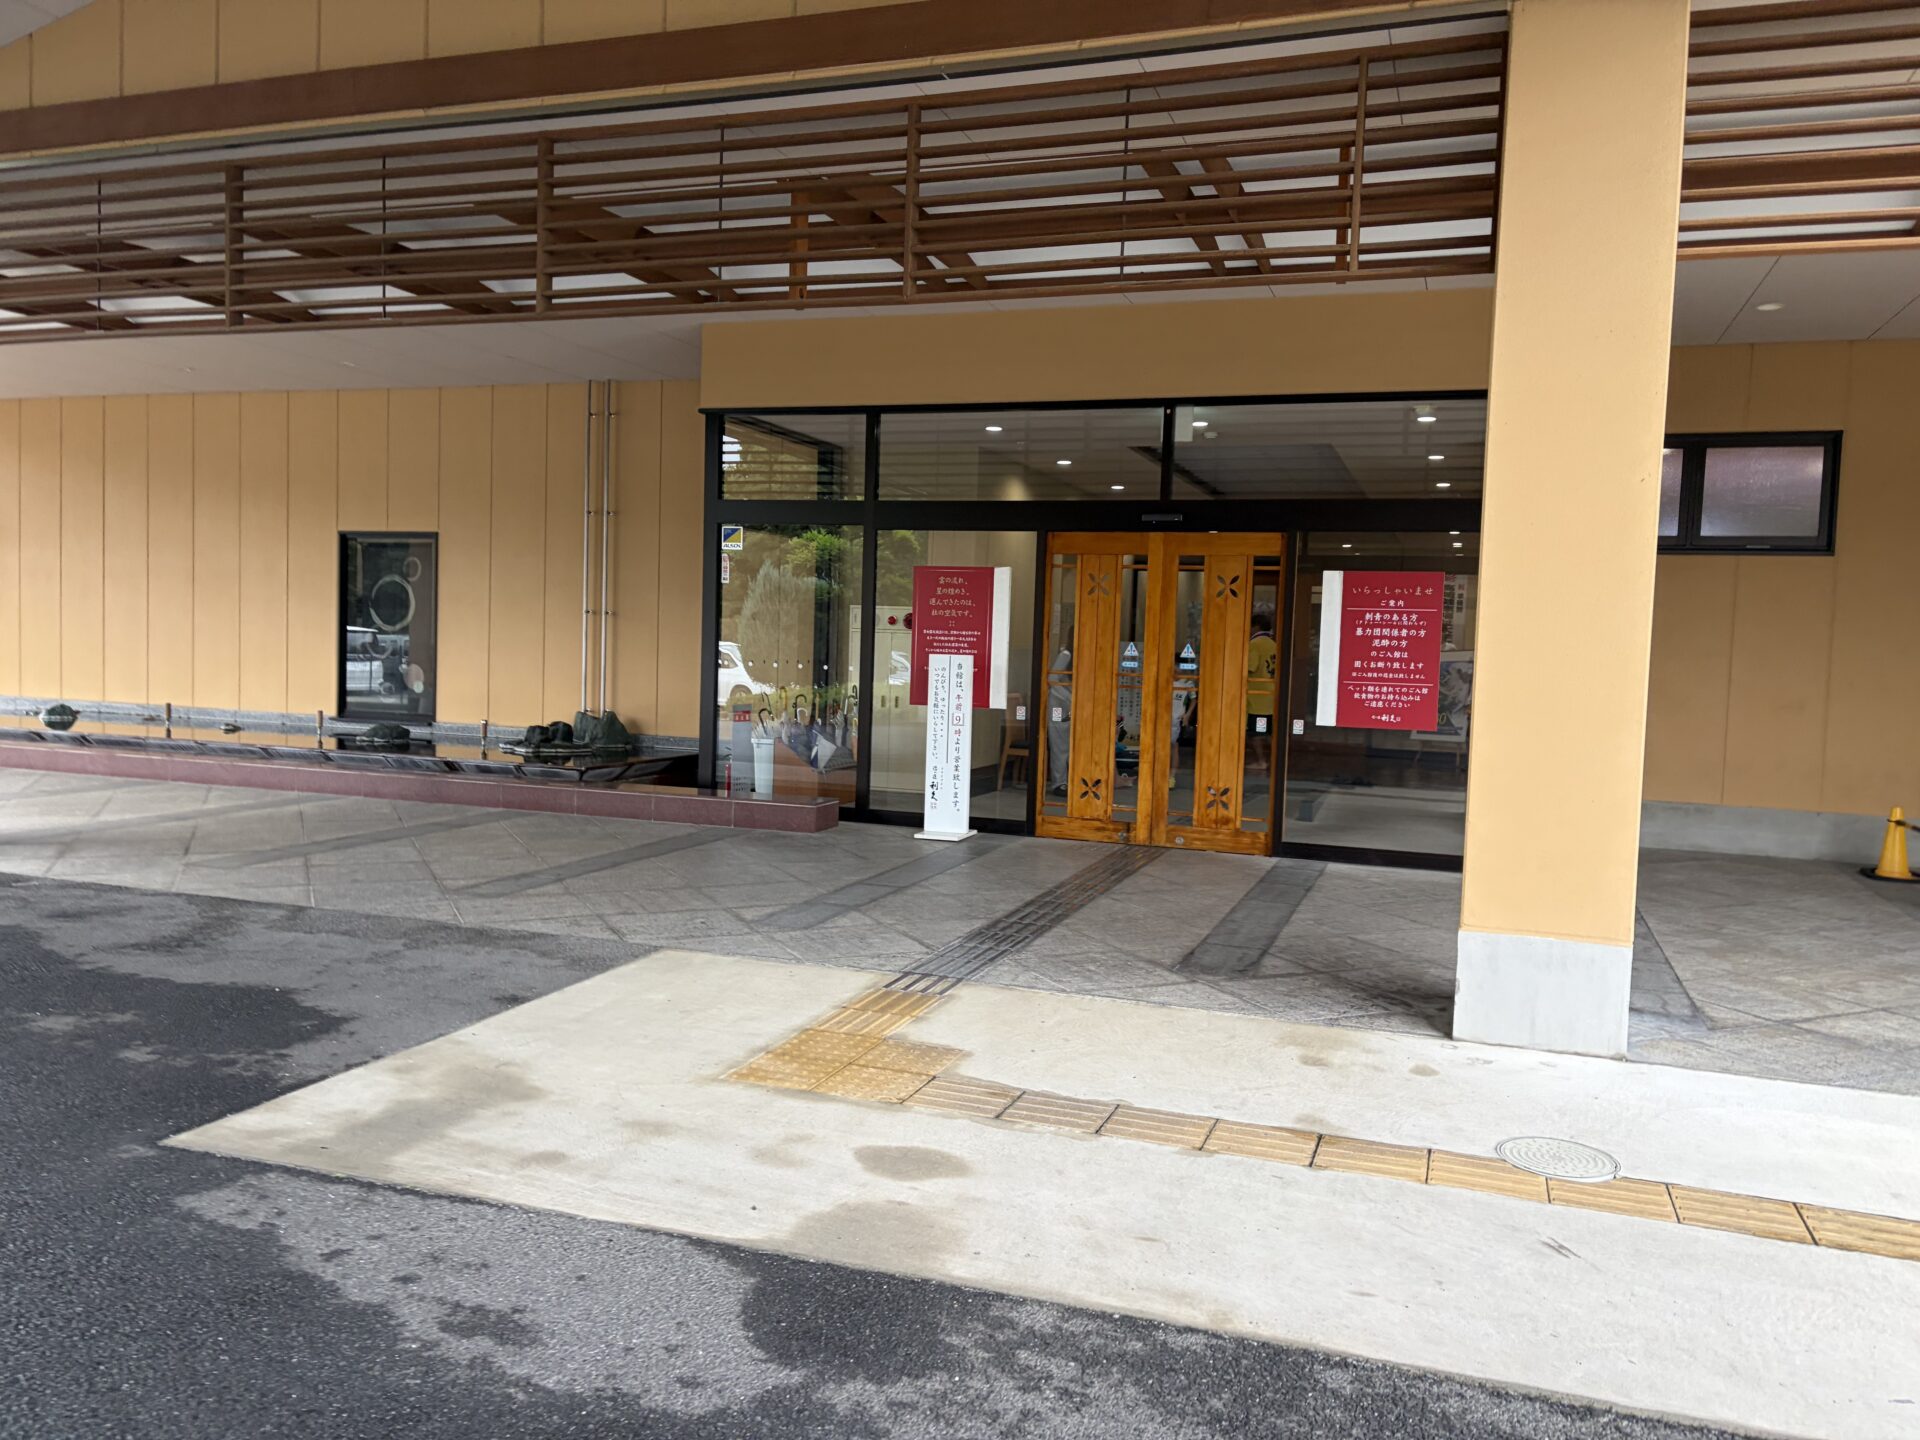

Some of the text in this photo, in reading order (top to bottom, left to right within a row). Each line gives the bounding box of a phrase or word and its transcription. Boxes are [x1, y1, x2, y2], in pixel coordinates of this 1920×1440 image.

[1352, 586, 1433, 596] いらっしゃいませ
[1355, 627, 1426, 638] 暴力団関係者の方
[1371, 639, 1408, 648] 泥酔の方
[1370, 650, 1408, 659] のご入館は
[1354, 660, 1424, 670] 固くお断り致します
[1347, 685, 1429, 695] ペット類を連れてのご入館
[1353, 692, 1421, 702] 飲食物のお持ち込みは
[1364, 700, 1411, 708] ご遠慮ください
